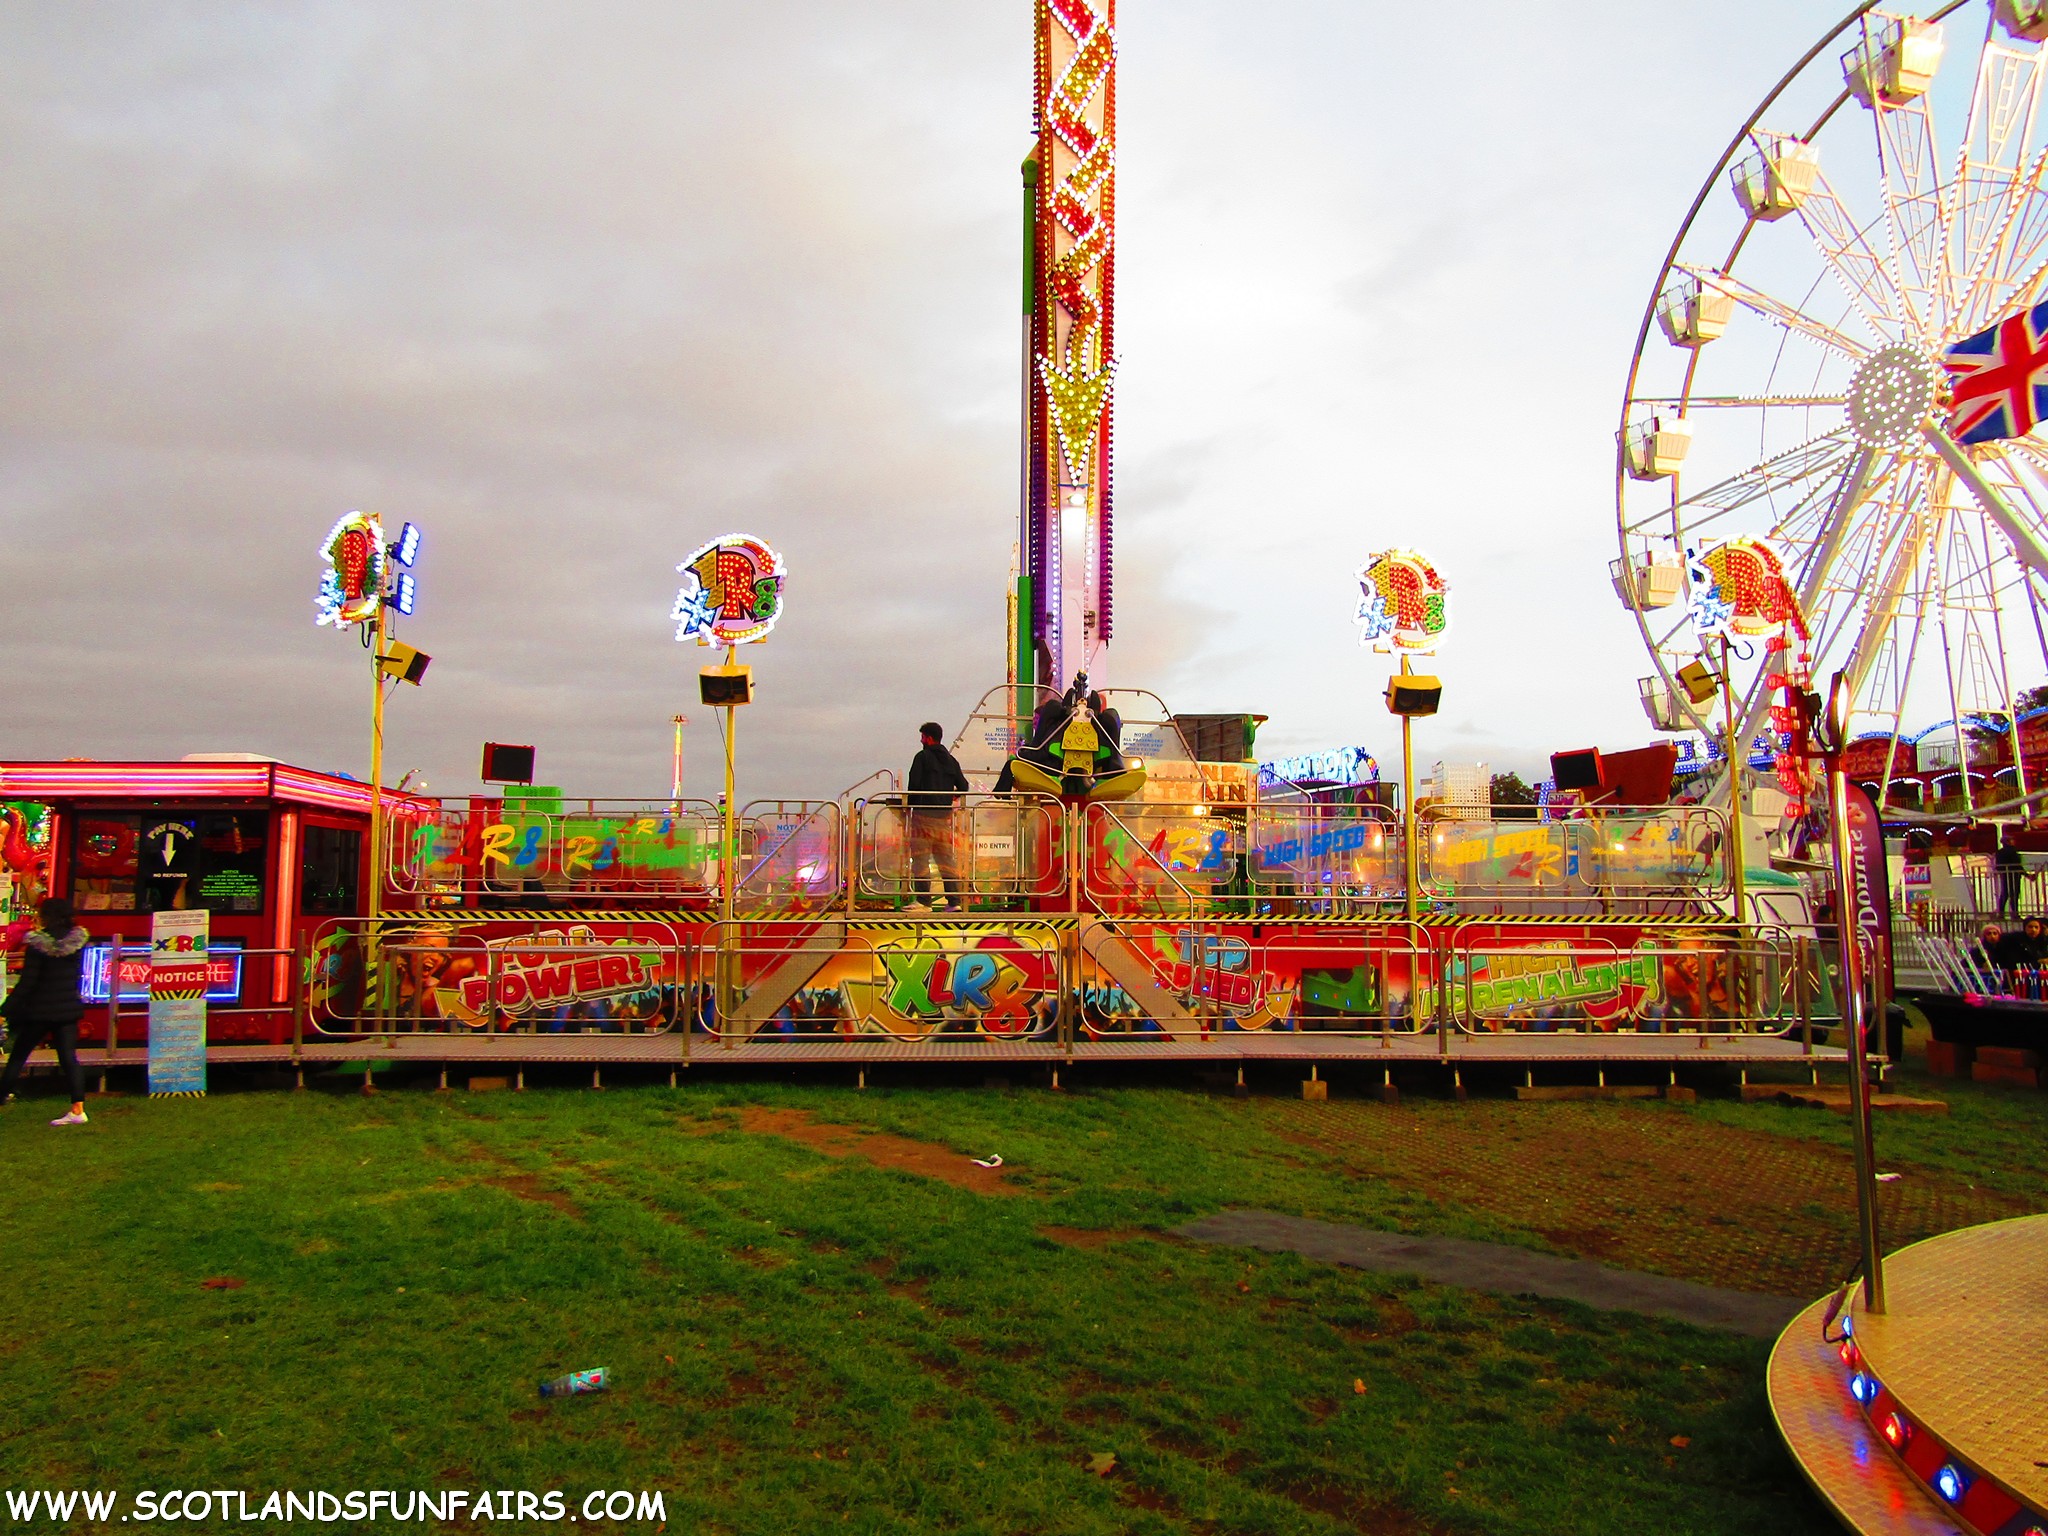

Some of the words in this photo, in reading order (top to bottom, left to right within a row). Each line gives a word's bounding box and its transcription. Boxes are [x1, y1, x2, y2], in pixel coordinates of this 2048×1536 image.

[147, 823, 167, 840] PAY
[168, 822, 194, 840] HERE
[412, 824, 543, 865] XLR8
[1103, 828, 1227, 870] XLR8
[1264, 838, 1304, 867] HIGH
[1310, 825, 1366, 857] SPEED
[1178, 929, 1248, 970] TOP
[1488, 940, 1572, 980] HIGH
[153, 971, 205, 983] NOTICE
[462, 954, 645, 1011] POWER!
[879, 935, 1035, 1038] XLR8
